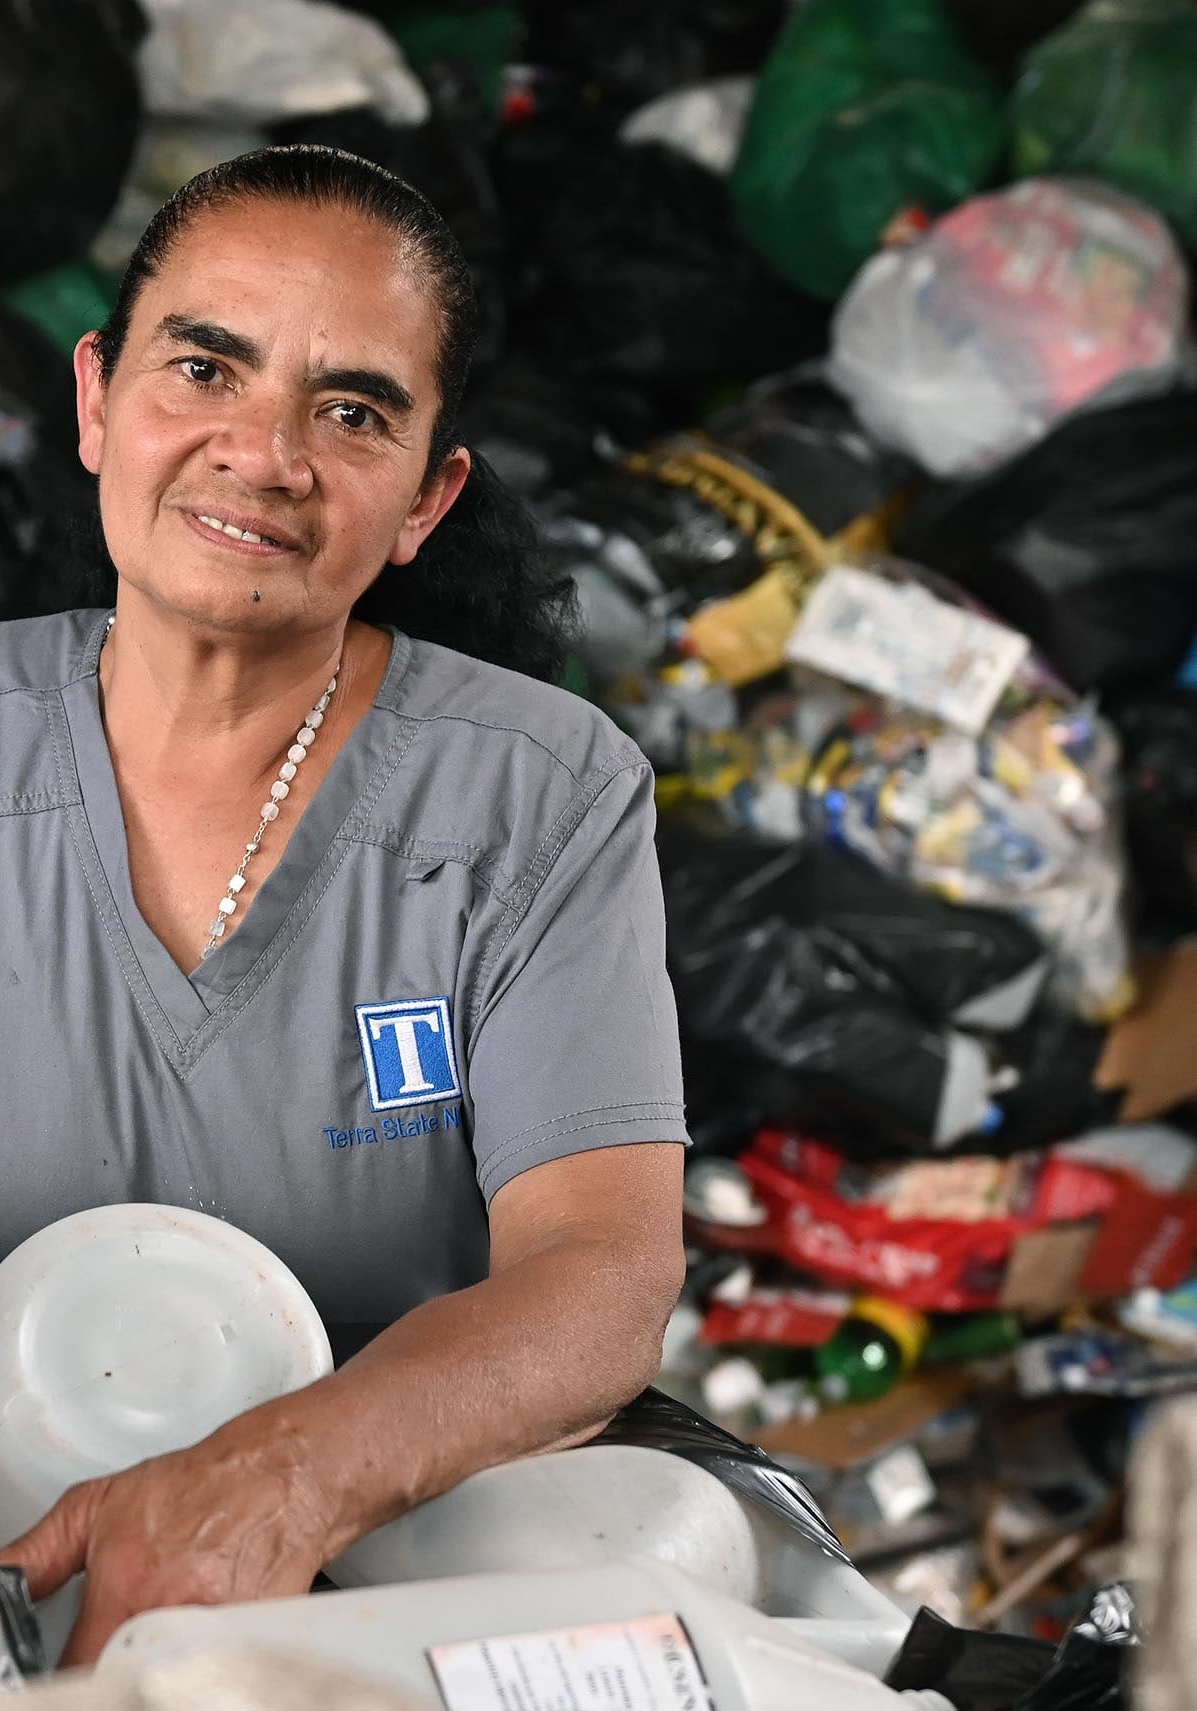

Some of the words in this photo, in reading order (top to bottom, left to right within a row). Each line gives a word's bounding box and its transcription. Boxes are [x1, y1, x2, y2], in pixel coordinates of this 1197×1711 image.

[368, 1011, 440, 1094] T
[322, 1126, 378, 1149] Terra
[381, 1113, 439, 1140] State
[443, 1107, 463, 1131] N
